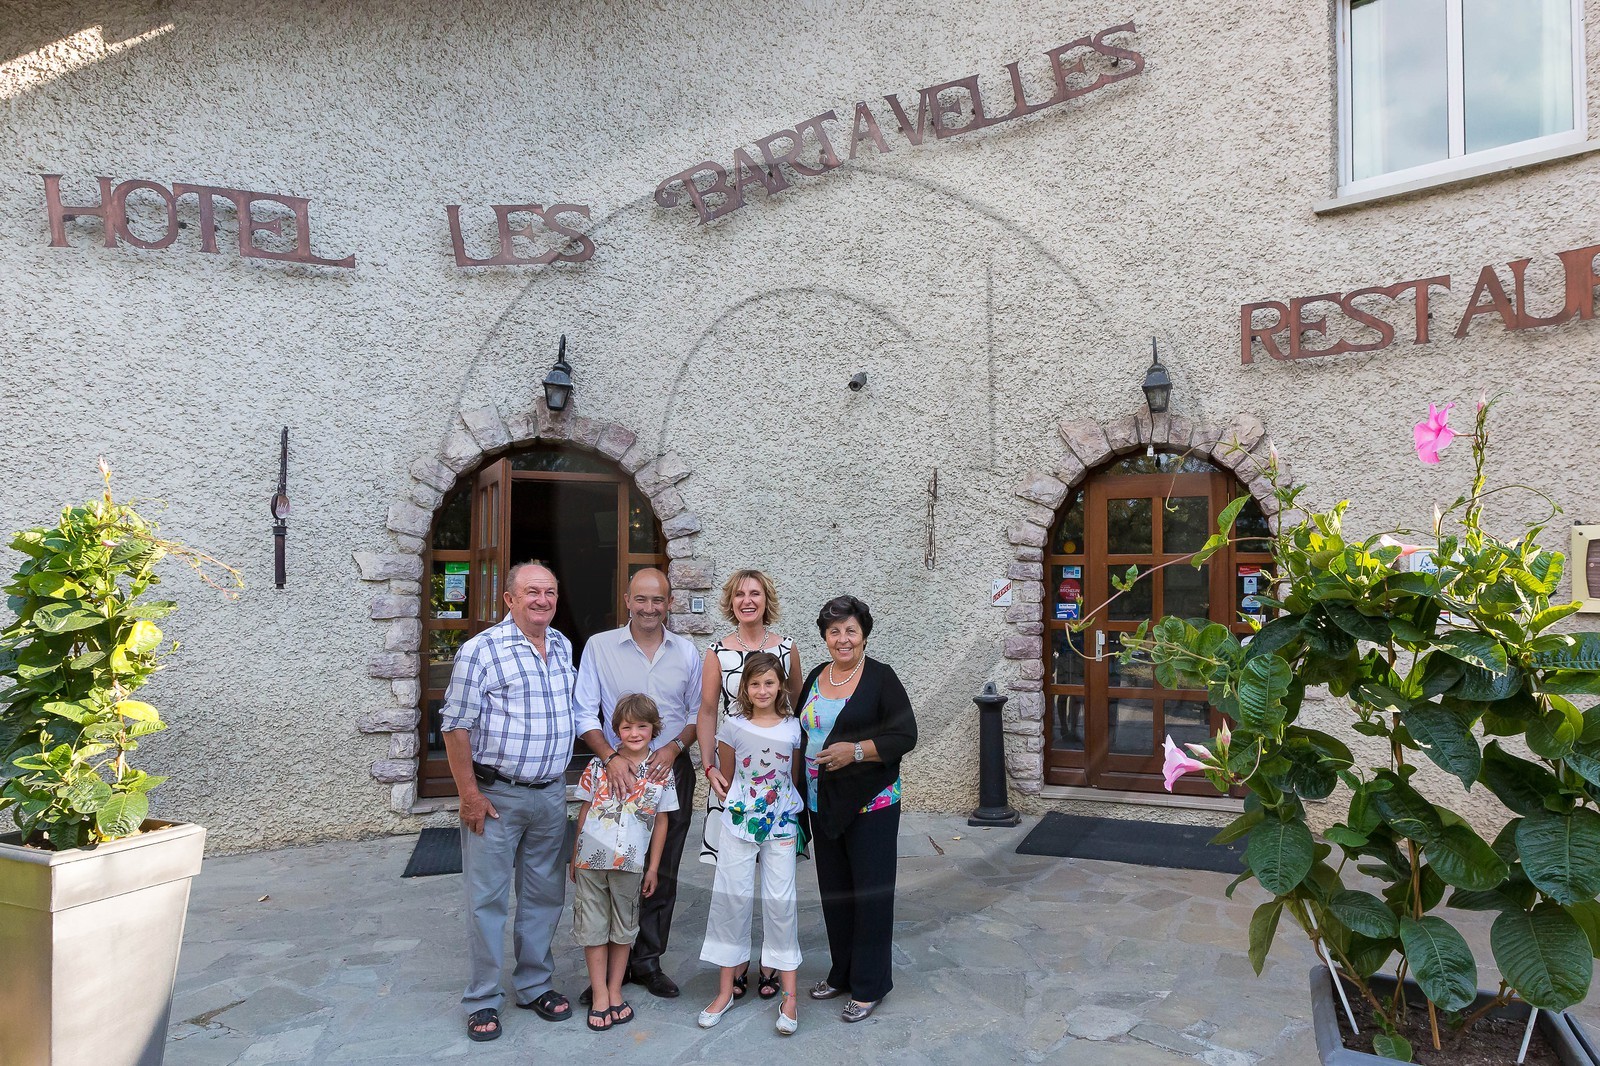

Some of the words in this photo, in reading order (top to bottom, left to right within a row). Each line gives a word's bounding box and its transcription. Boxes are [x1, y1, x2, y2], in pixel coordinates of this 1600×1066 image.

[40, 173, 355, 268] HOTEL
[446, 203, 595, 267] LES
[654, 20, 1145, 226] BARTAVELLES
